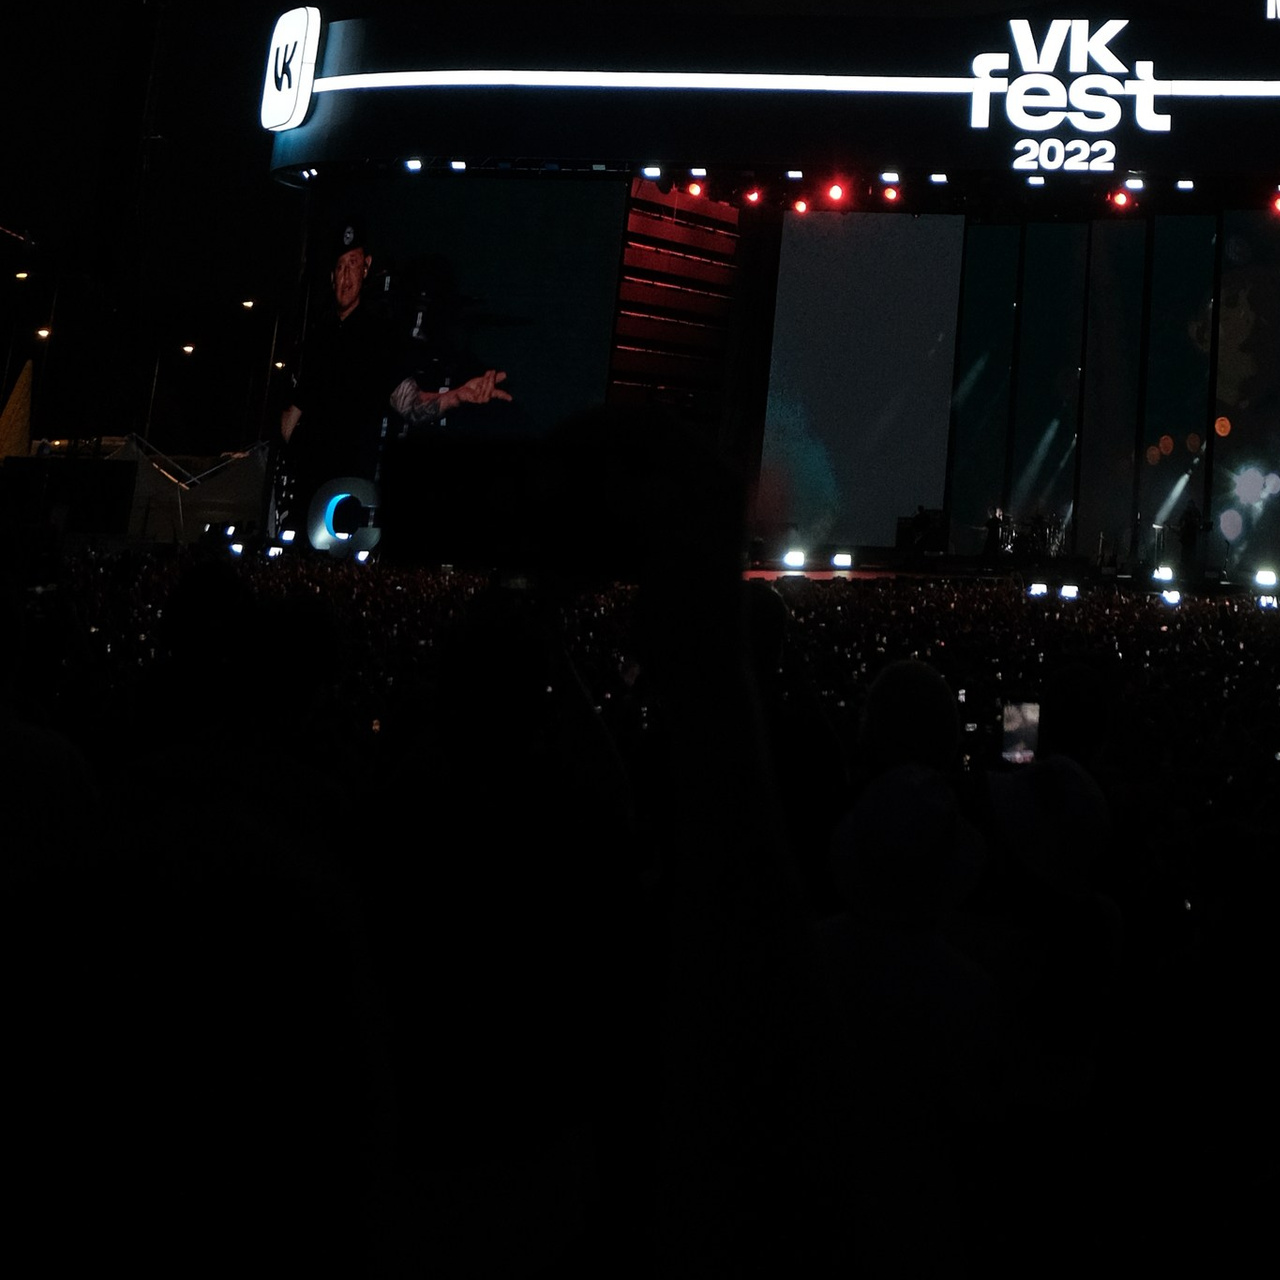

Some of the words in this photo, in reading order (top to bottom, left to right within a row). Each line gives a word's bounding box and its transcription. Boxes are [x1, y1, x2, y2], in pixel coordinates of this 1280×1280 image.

[1008, 19, 1130, 73] VK
[970, 52, 1172, 132] fest
[1012, 138, 1117, 172] 2022
